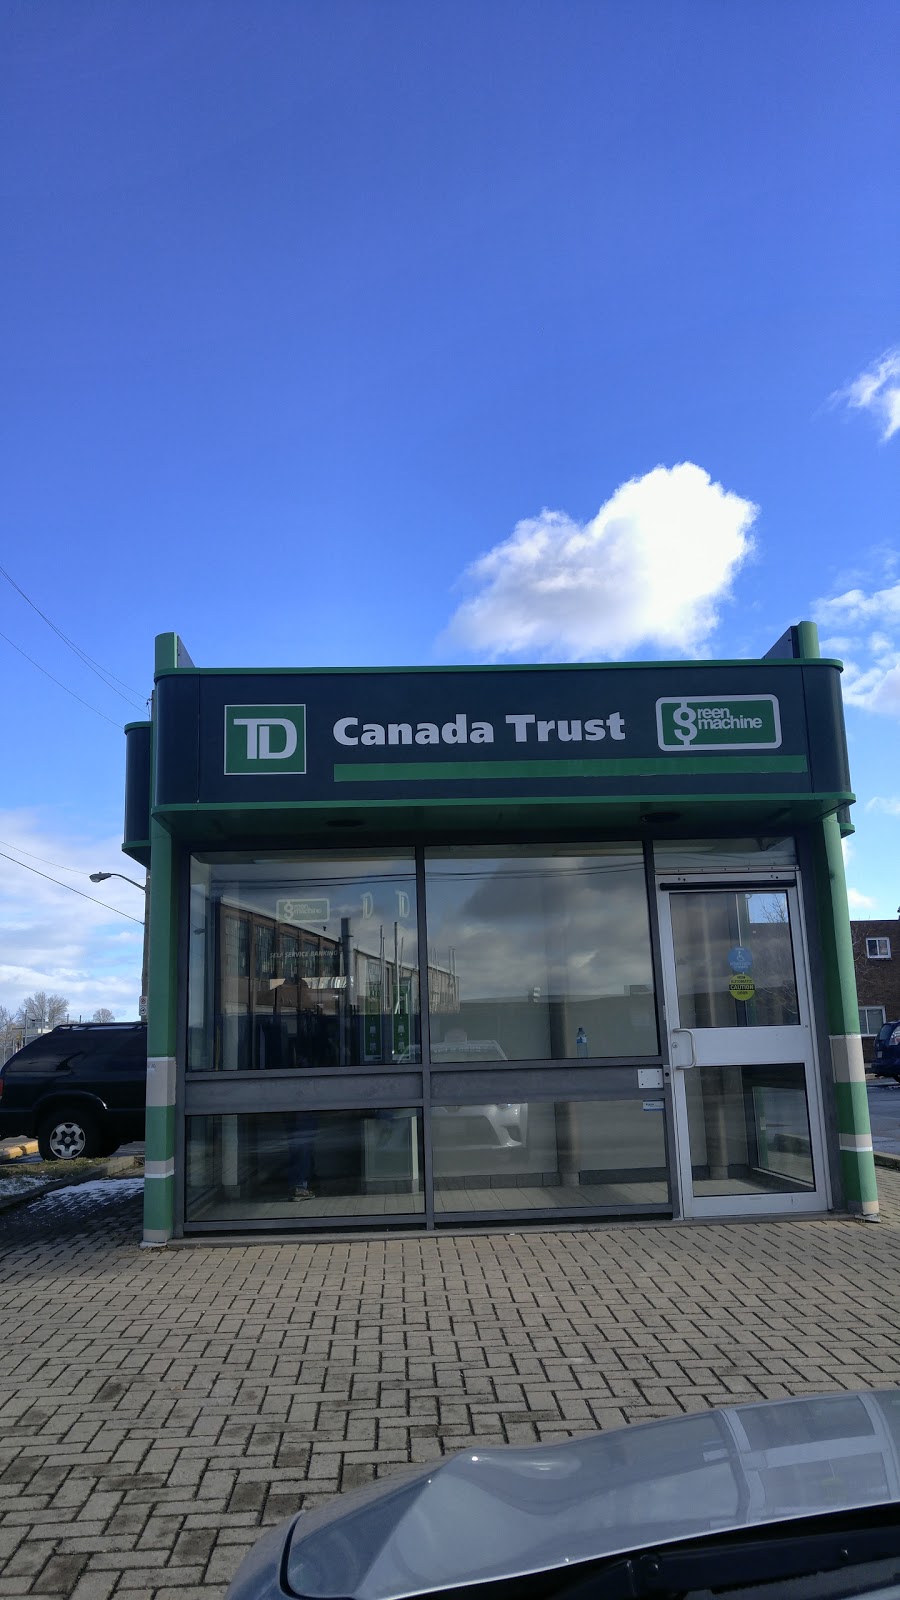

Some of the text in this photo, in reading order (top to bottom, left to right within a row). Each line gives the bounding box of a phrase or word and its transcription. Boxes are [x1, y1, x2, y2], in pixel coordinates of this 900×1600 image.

[233, 717, 298, 760] TD
[332, 711, 626, 746] Canada Trust
[698, 715, 762, 729] machine
